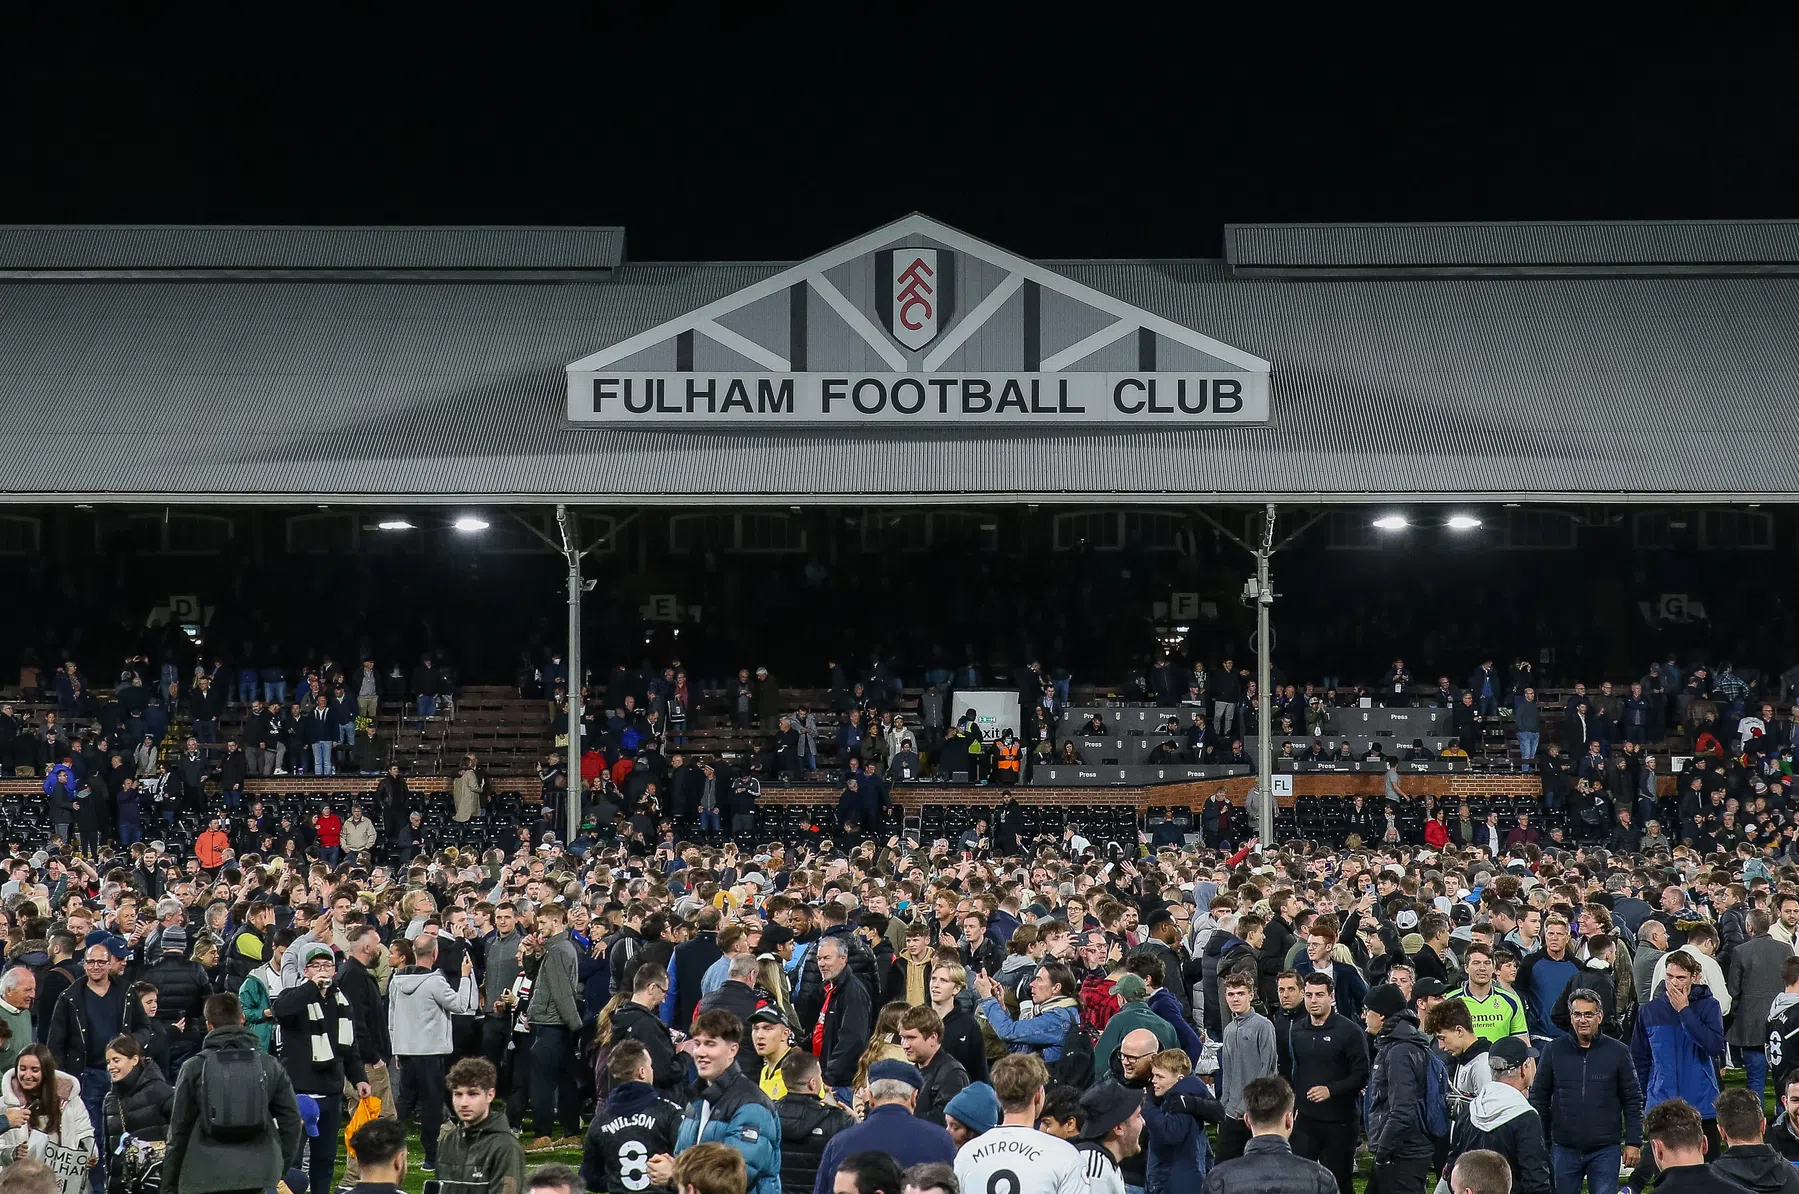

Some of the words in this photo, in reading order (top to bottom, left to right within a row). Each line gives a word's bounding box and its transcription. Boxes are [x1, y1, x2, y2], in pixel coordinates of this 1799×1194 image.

[592, 378, 794, 414] FULHAM
[821, 377, 1086, 414] FOOTBALL
[1112, 377, 1244, 414] CLUB
[176, 599, 192, 617] D
[656, 598, 670, 616] E
[1179, 596, 1192, 614] F
[1665, 597, 1683, 616] G
[982, 726, 1000, 738] xit
[1274, 780, 1290, 791] FL
[1471, 1013, 1503, 1022] emon
[1769, 1030, 1783, 1066] 8
[606, 1113, 656, 1135] WILSON
[45, 1146, 73, 1165] OME
[76, 1154, 88, 1166] O
[972, 1141, 1044, 1163] MITROVIĆ
[617, 1140, 651, 1191] 8
